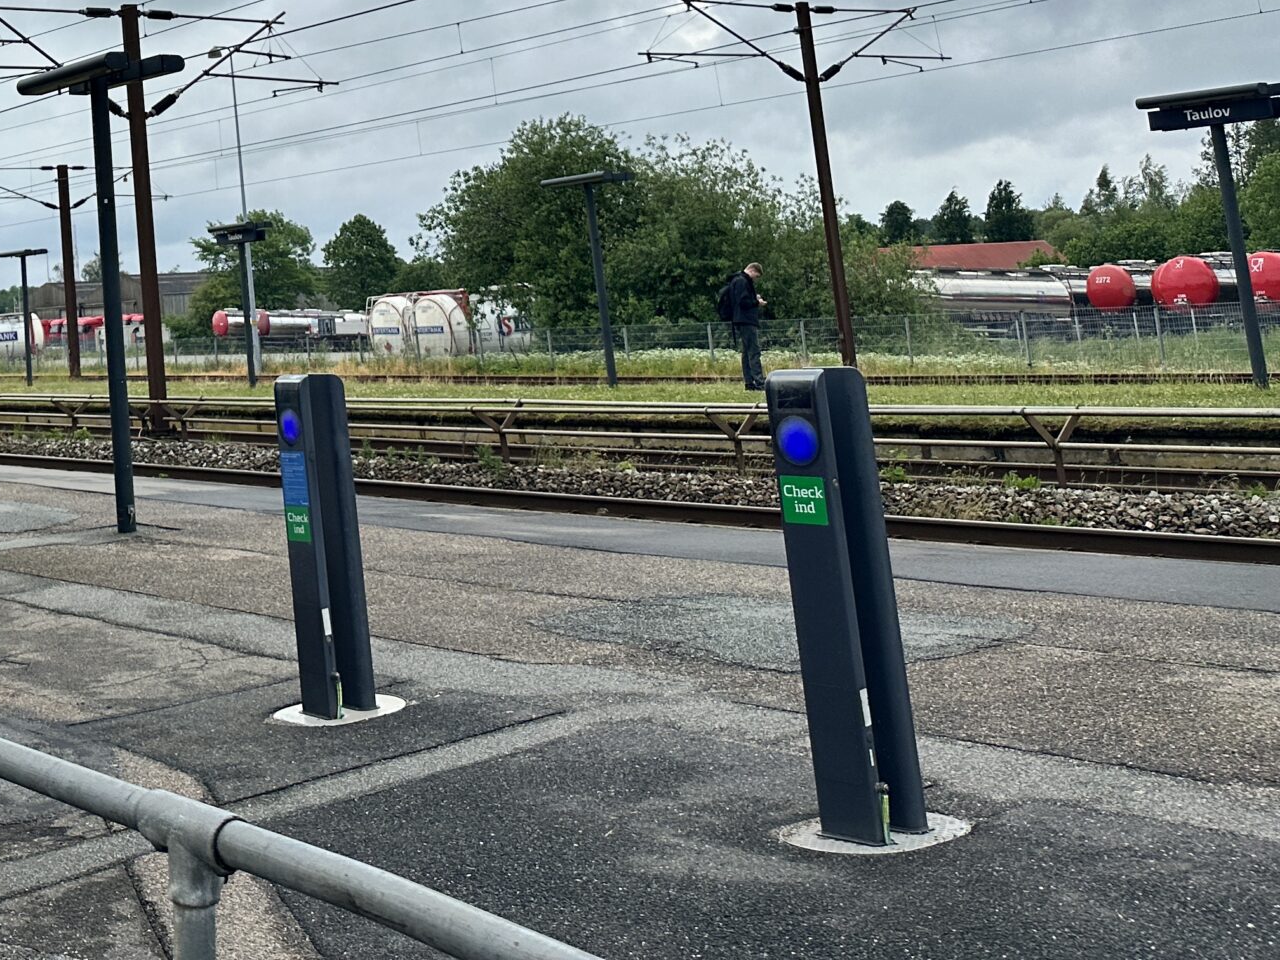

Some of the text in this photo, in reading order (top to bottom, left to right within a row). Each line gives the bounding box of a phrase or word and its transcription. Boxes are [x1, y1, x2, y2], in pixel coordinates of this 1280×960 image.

[1184, 106, 1230, 121] Taulov
[783, 484, 824, 499] Check
[794, 500, 816, 514] ind
[288, 512, 309, 523] Check
[293, 524, 305, 534] ind
